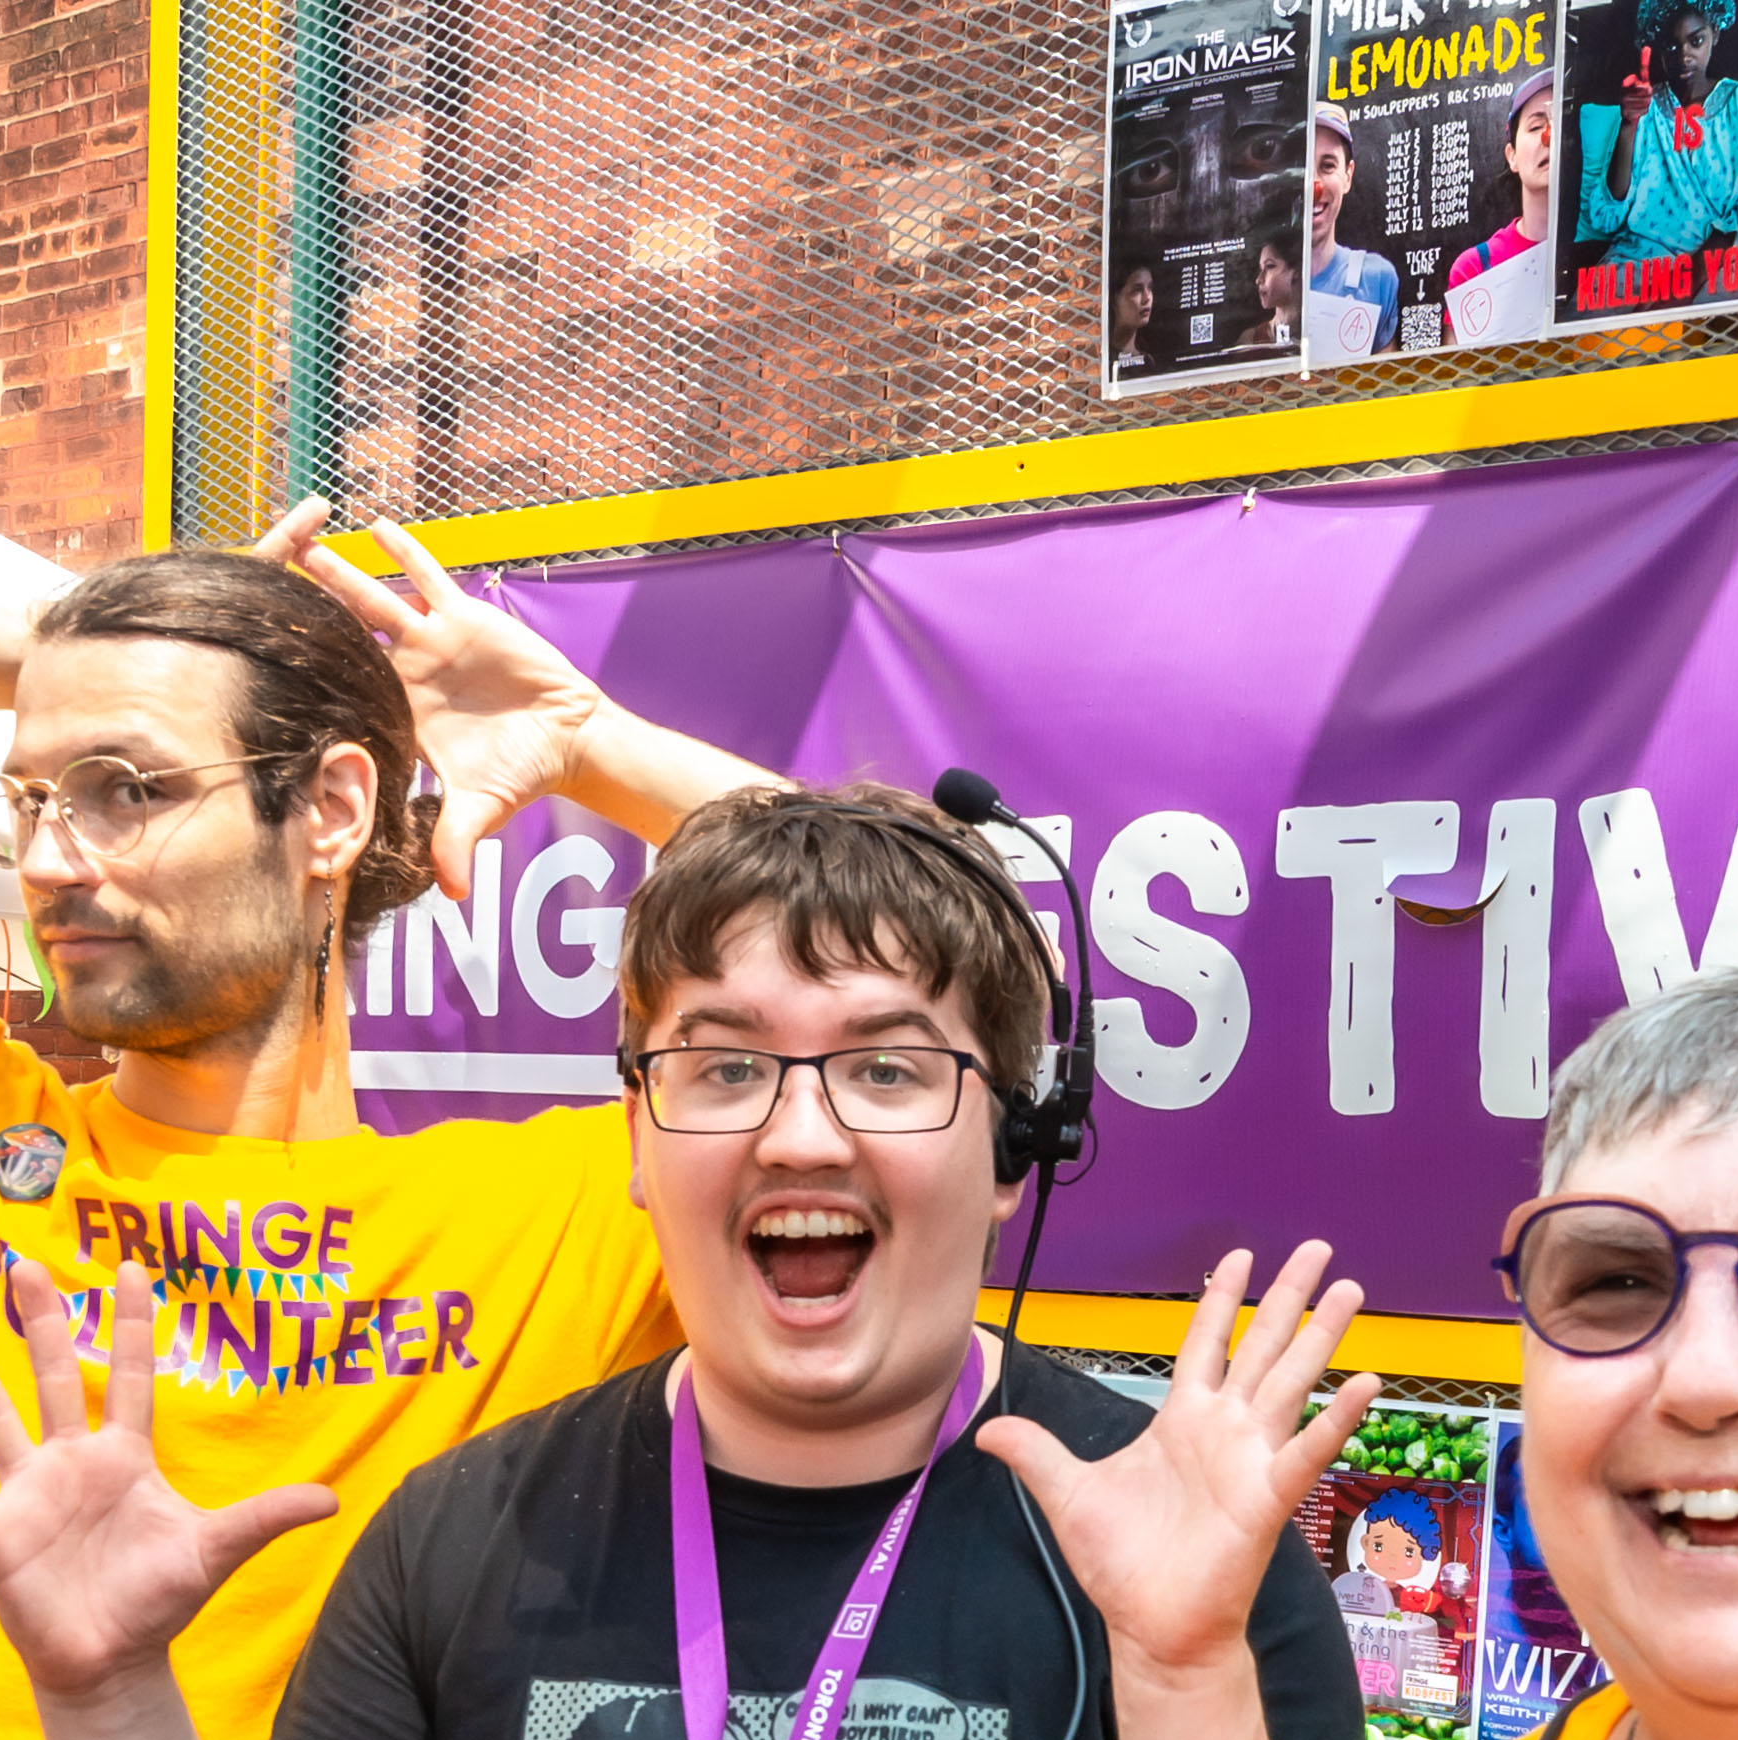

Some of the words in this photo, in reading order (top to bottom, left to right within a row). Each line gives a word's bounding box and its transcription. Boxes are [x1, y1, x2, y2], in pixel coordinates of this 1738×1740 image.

[1195, 29, 1226, 47] THE
[1125, 51, 1196, 88] IRON
[1204, 31, 1296, 73] MASK
[1327, 12, 1546, 101] LEMONADE
[1349, 107, 1360, 122] IN
[1363, 92, 1440, 120] SOULPEPPER'S
[1447, 88, 1469, 105] RBC
[1473, 83, 1514, 101] STUDIO
[1388, 129, 1411, 146] JULY
[1674, 103, 1704, 152] IS
[1387, 142, 1410, 158] JULY
[1387, 155, 1410, 171] JULY
[1432, 146, 1469, 163] 1:00PM
[1386, 168, 1410, 184] JULY
[1412, 166, 1419, 180] 7
[1431, 159, 1469, 176] 8:00PM
[1386, 181, 1409, 197] JULY
[1412, 179, 1420, 192] 8
[1431, 170, 1474, 189] 10:00PM
[1386, 194, 1409, 210] JULY
[1412, 192, 1418, 205] 9
[1431, 184, 1469, 202] 8:00PM
[1385, 220, 1409, 236] JULY
[1412, 218, 1423, 232] 12
[1432, 210, 1469, 229] 6:30PM
[1386, 207, 1410, 223] JULY
[1412, 205, 1421, 218] 11
[1432, 198, 1467, 215] 1:00PM
[1406, 247, 1441, 264] TICKET
[1411, 260, 1435, 276] LINK
[1576, 253, 1692, 312] KILLING
[346, 833, 653, 1019] ING
[75, 1199, 354, 1274] FRINGE
[1361, 1621, 1374, 1641] &
[1380, 1625, 1408, 1641] the
[1404, 1686, 1455, 1702] KIDSFEST
[1486, 1692, 1520, 1705] WITH
[863, 1703, 903, 1721] WHY
[906, 1705, 957, 1726] CAN'T
[1484, 1702, 1541, 1721] KEITH
[1482, 1721, 1530, 1733] TORONTO
